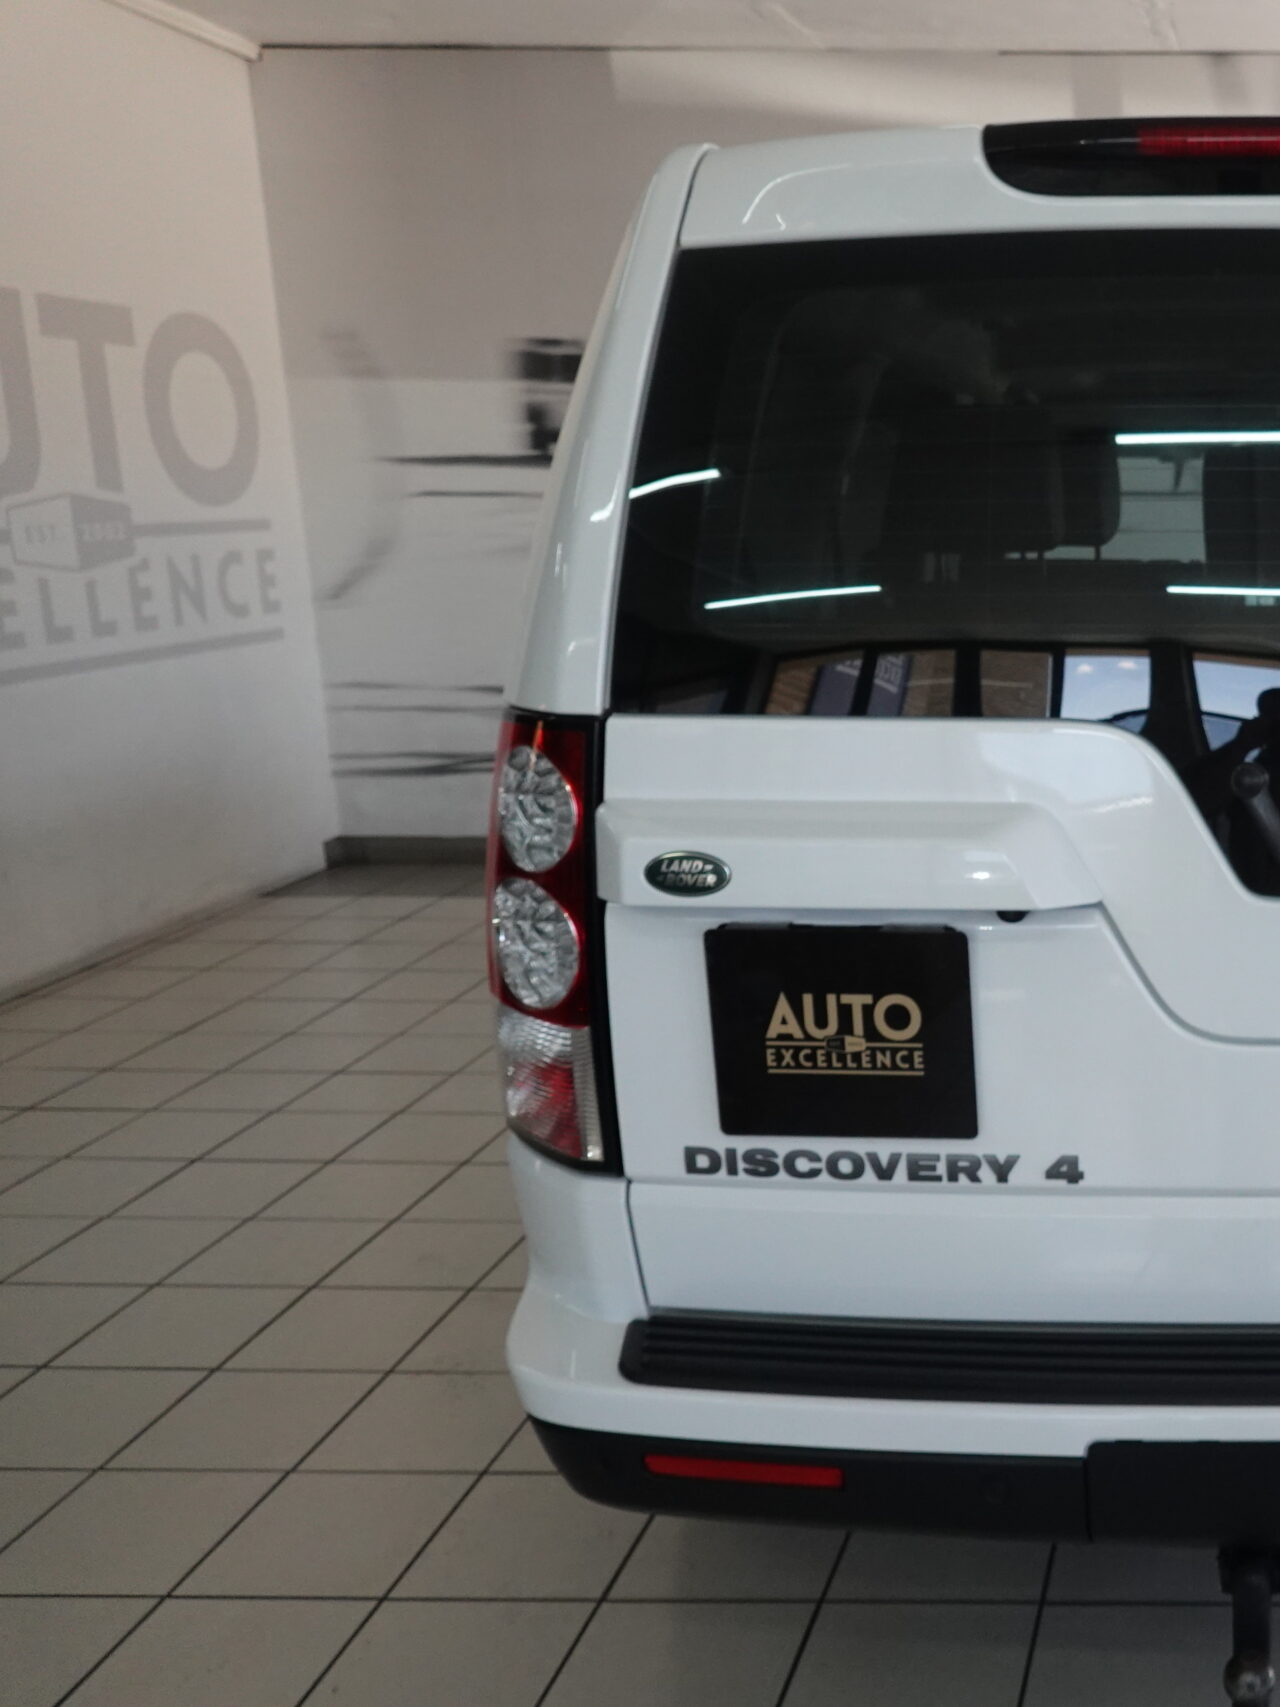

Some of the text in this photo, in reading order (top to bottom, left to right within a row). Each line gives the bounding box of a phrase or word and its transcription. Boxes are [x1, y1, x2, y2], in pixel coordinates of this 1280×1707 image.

[660, 859, 704, 873] LAND
[664, 873, 718, 888] ROVER
[766, 992, 923, 1042] AUTO
[767, 1047, 925, 1070] EXCELLENCE
[684, 1146, 1085, 1184] DISCOVERY 4
